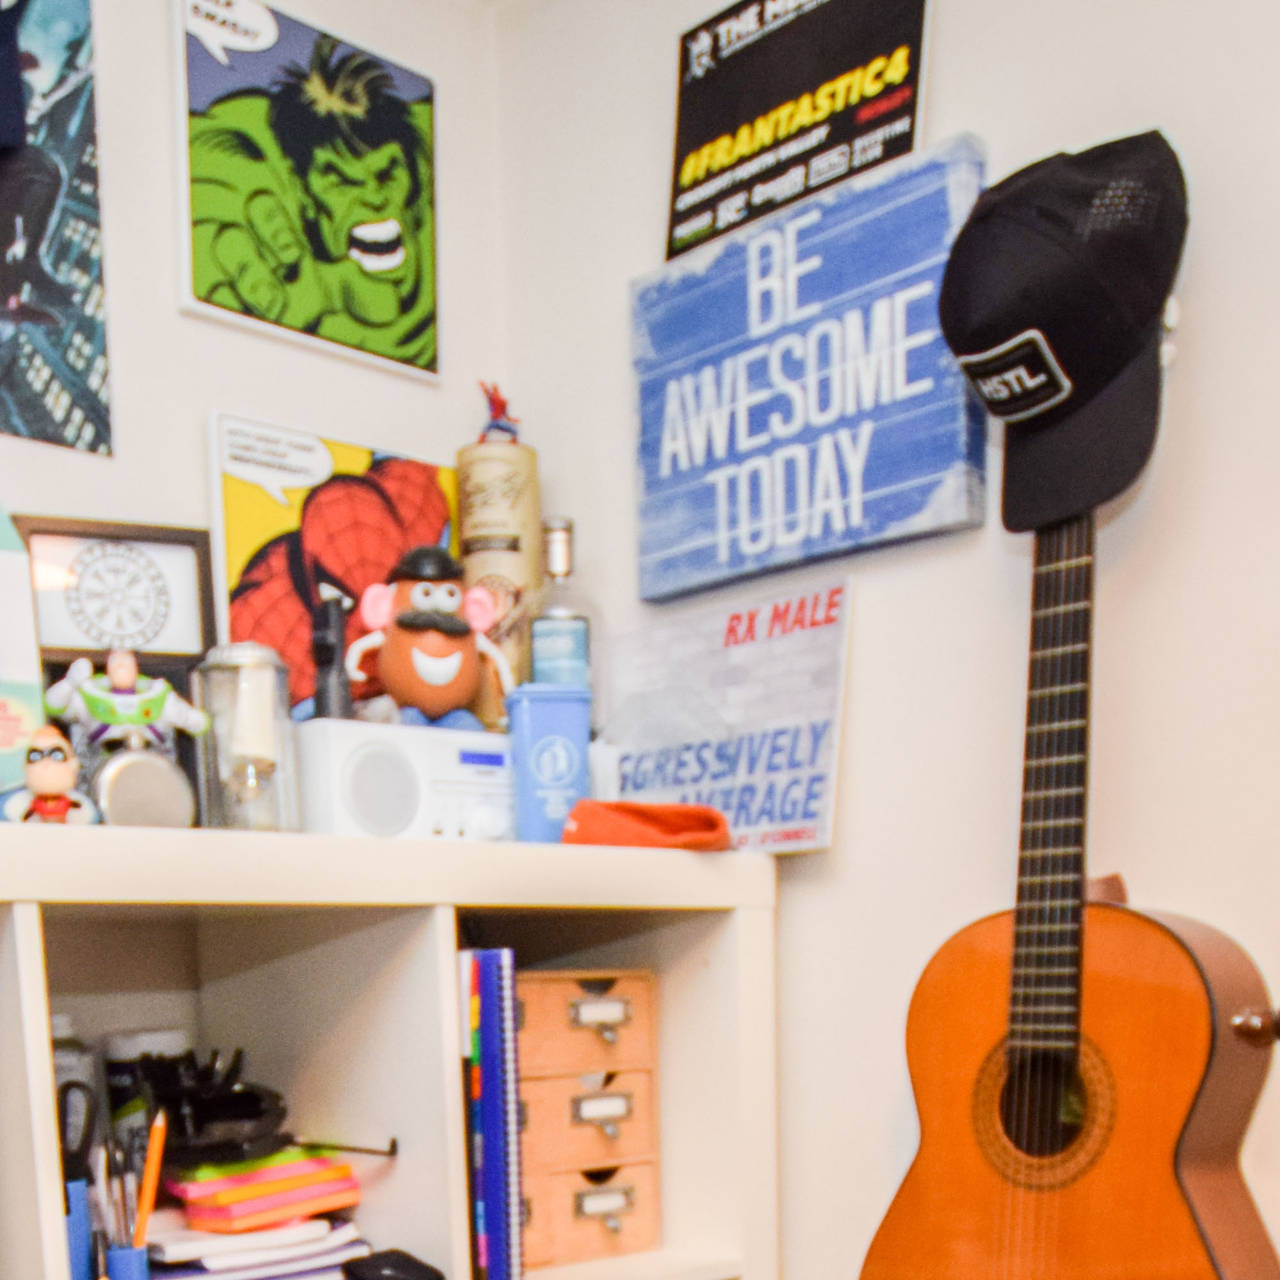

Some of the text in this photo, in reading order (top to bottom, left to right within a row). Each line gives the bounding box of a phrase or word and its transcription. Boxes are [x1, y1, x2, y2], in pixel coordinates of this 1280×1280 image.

[678, 44, 910, 188] #FRANTASTIC4
[747, 209, 823, 341] BE
[658, 281, 936, 479] AWESOME
[706, 420, 874, 564] TODAY
[723, 587, 844, 648] RX MALE
[620, 719, 832, 793] GGRESSIVELY
[680, 774, 826, 828] ERAGE
